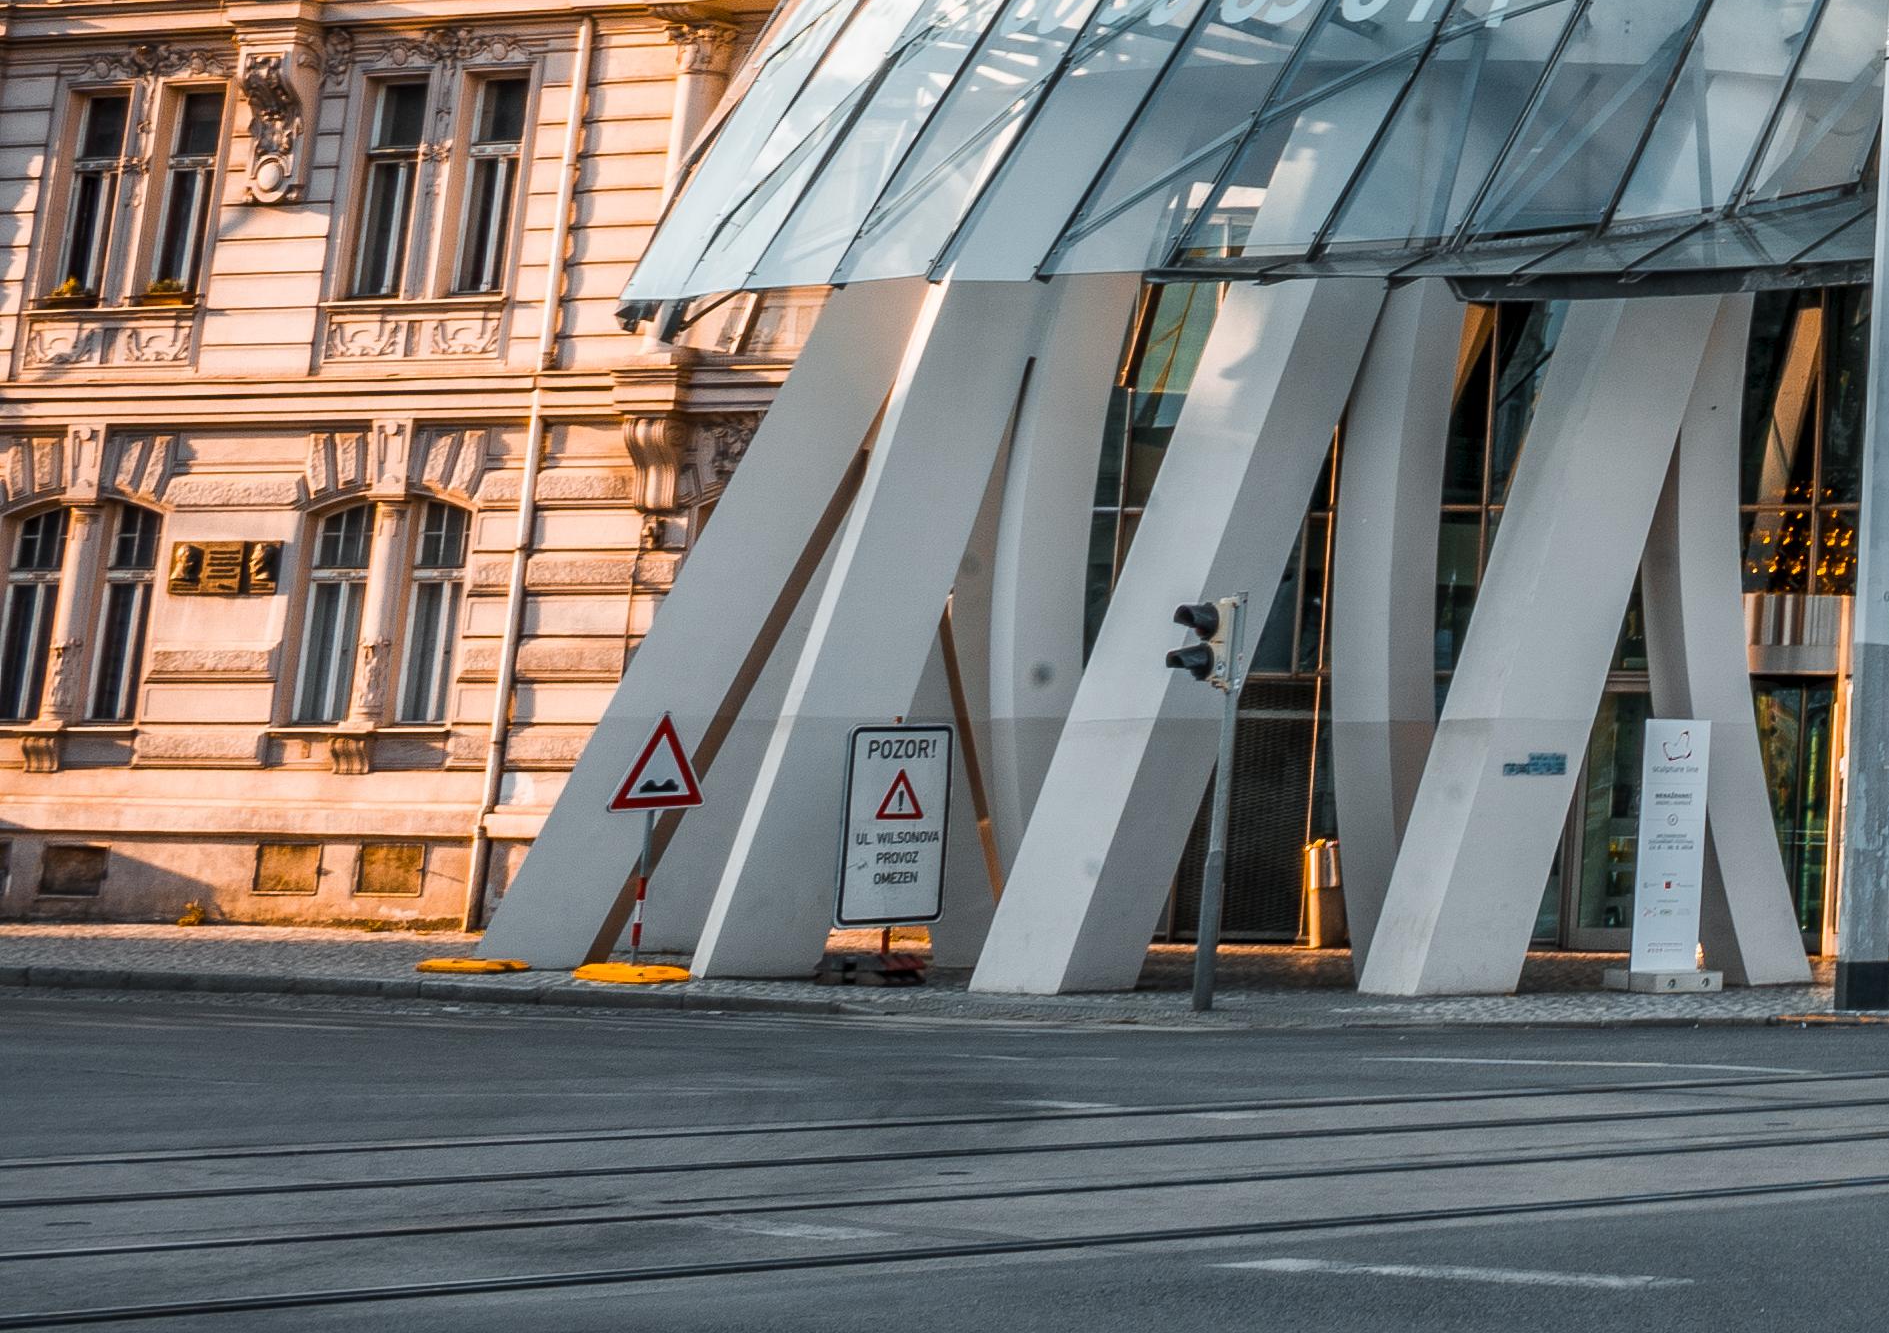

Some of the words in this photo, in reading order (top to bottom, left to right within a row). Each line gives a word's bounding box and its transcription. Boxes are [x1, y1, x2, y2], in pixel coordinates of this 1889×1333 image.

[867, 739, 937, 759] POZOR!
[877, 831, 939, 845] WILSONOVA
[876, 851, 919, 865] PROVOZ
[873, 871, 918, 885] OMEZEN
